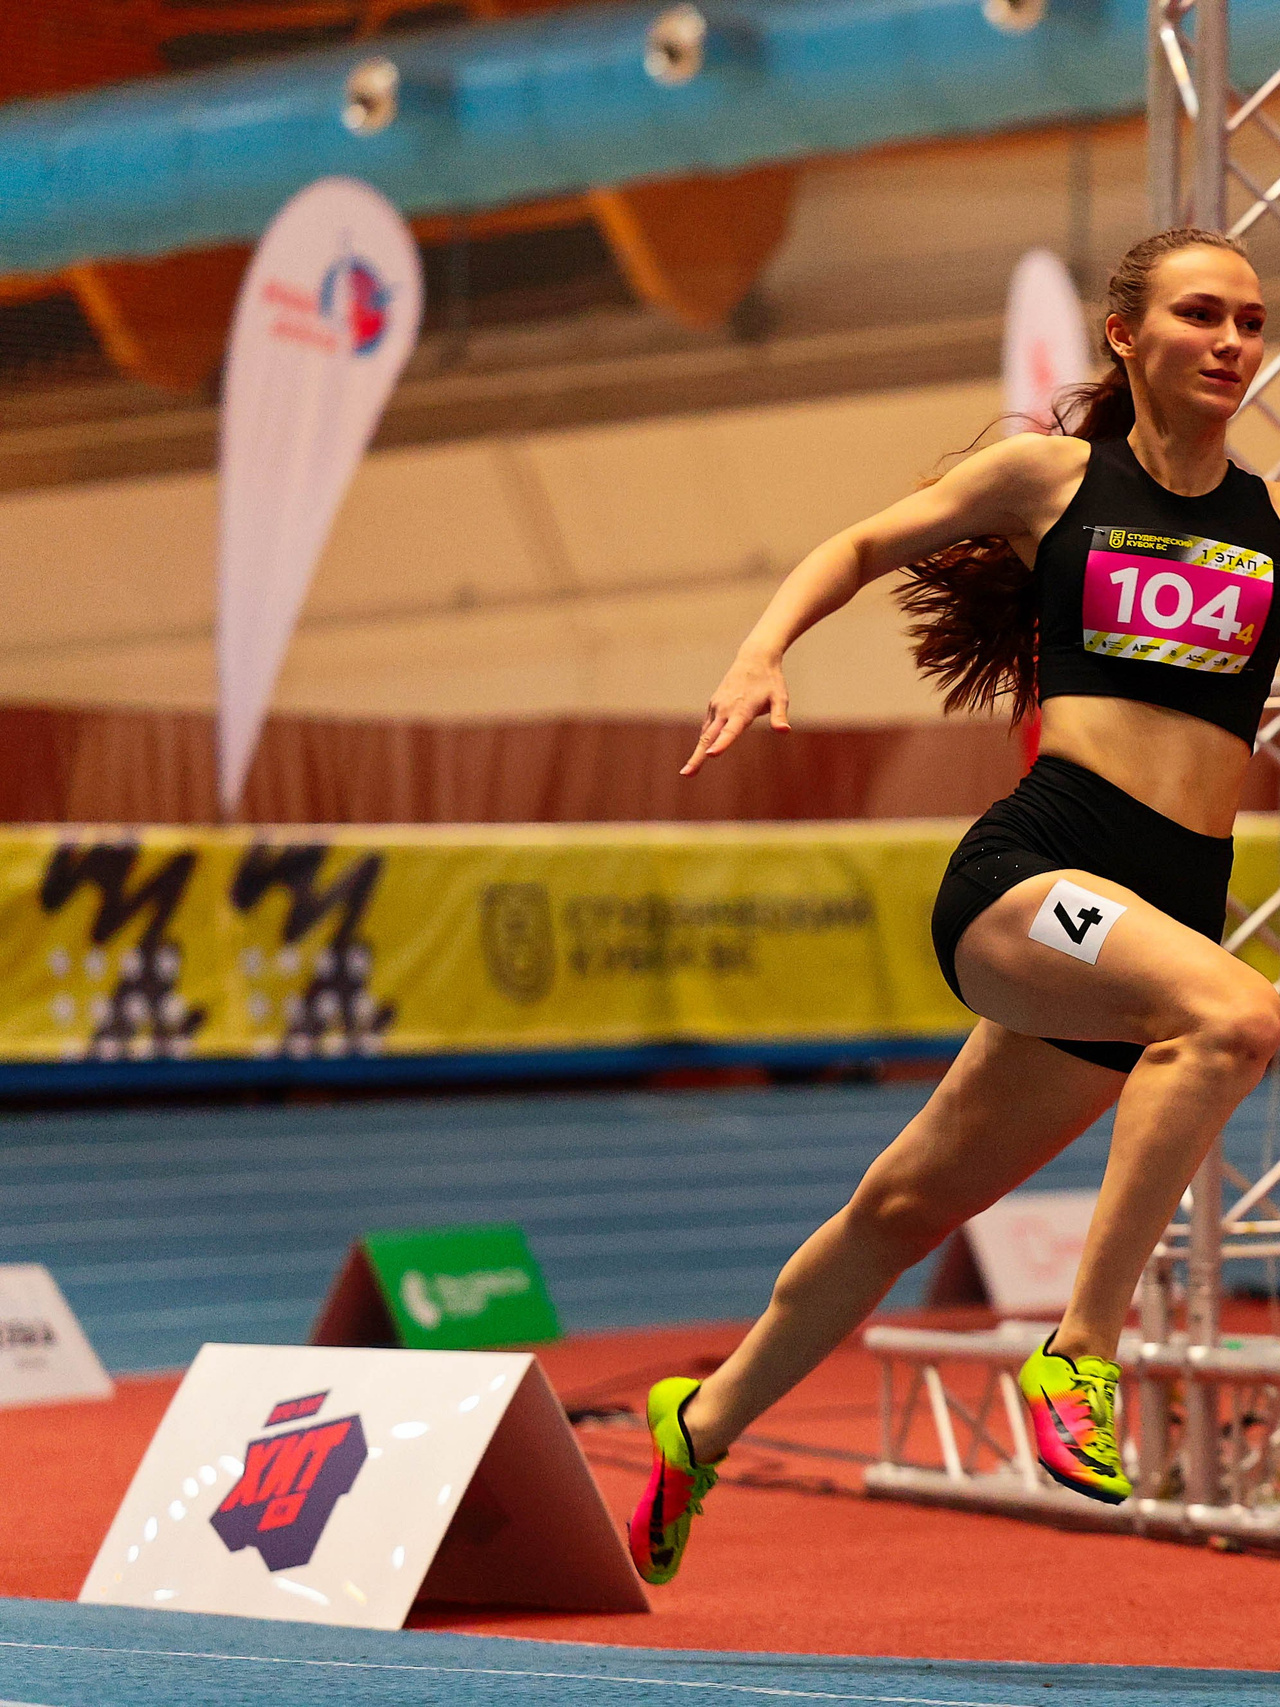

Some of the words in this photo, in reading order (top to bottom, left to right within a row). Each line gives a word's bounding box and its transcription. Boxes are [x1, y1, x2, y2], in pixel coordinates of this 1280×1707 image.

[1126, 540, 1154, 549] КУБОК
[1155, 543, 1168, 551] БС
[1127, 533, 1193, 548] СТУДЕНЧЕСКИЙ
[1202, 549, 1208, 560] 1
[1215, 552, 1257, 571] ЭТАП
[1109, 567, 1242, 641] 104
[1235, 623, 1255, 646] 4
[1053, 901, 1104, 945] 4
[219, 1421, 352, 1513] ХИТ
